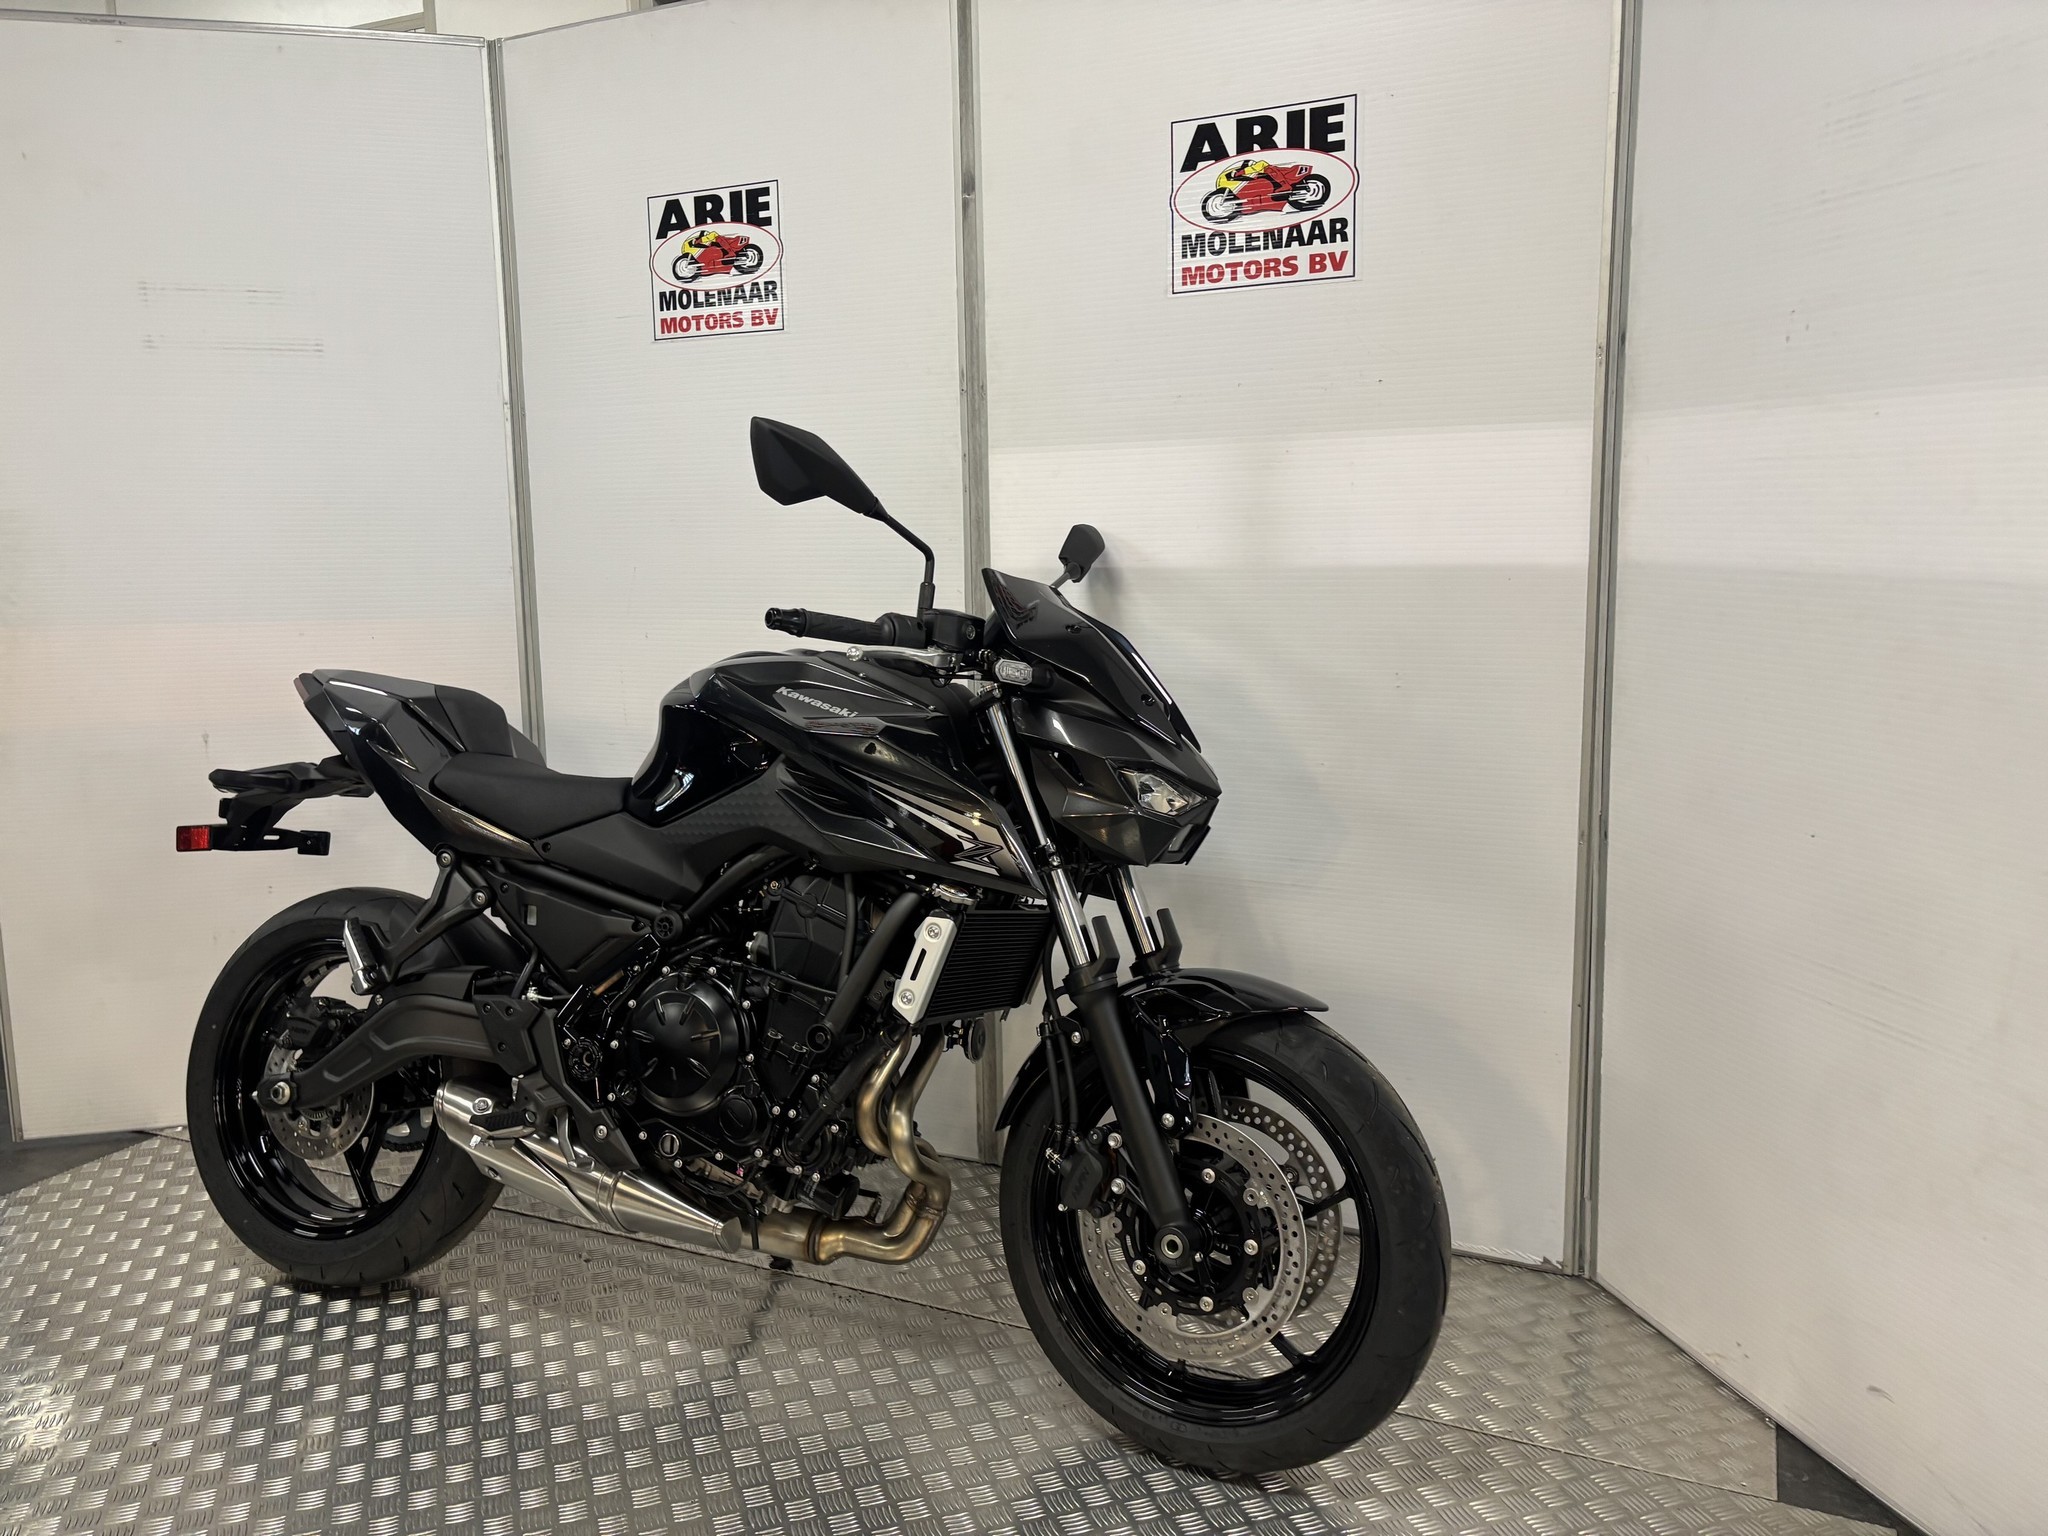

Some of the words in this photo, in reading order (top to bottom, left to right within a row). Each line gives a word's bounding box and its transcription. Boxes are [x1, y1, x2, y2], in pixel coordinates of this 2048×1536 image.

[1180, 103, 1345, 173] ARIE
[656, 187, 772, 240] ARIE
[1181, 218, 1348, 259] MOLENAAR
[1181, 256, 1298, 286] MOTORS
[1309, 251, 1348, 273] BV
[659, 280, 778, 311] MOLENAAR
[660, 311, 744, 334] MOTORS
[751, 308, 778, 327] BV
[776, 686, 859, 718] Kawasaki
